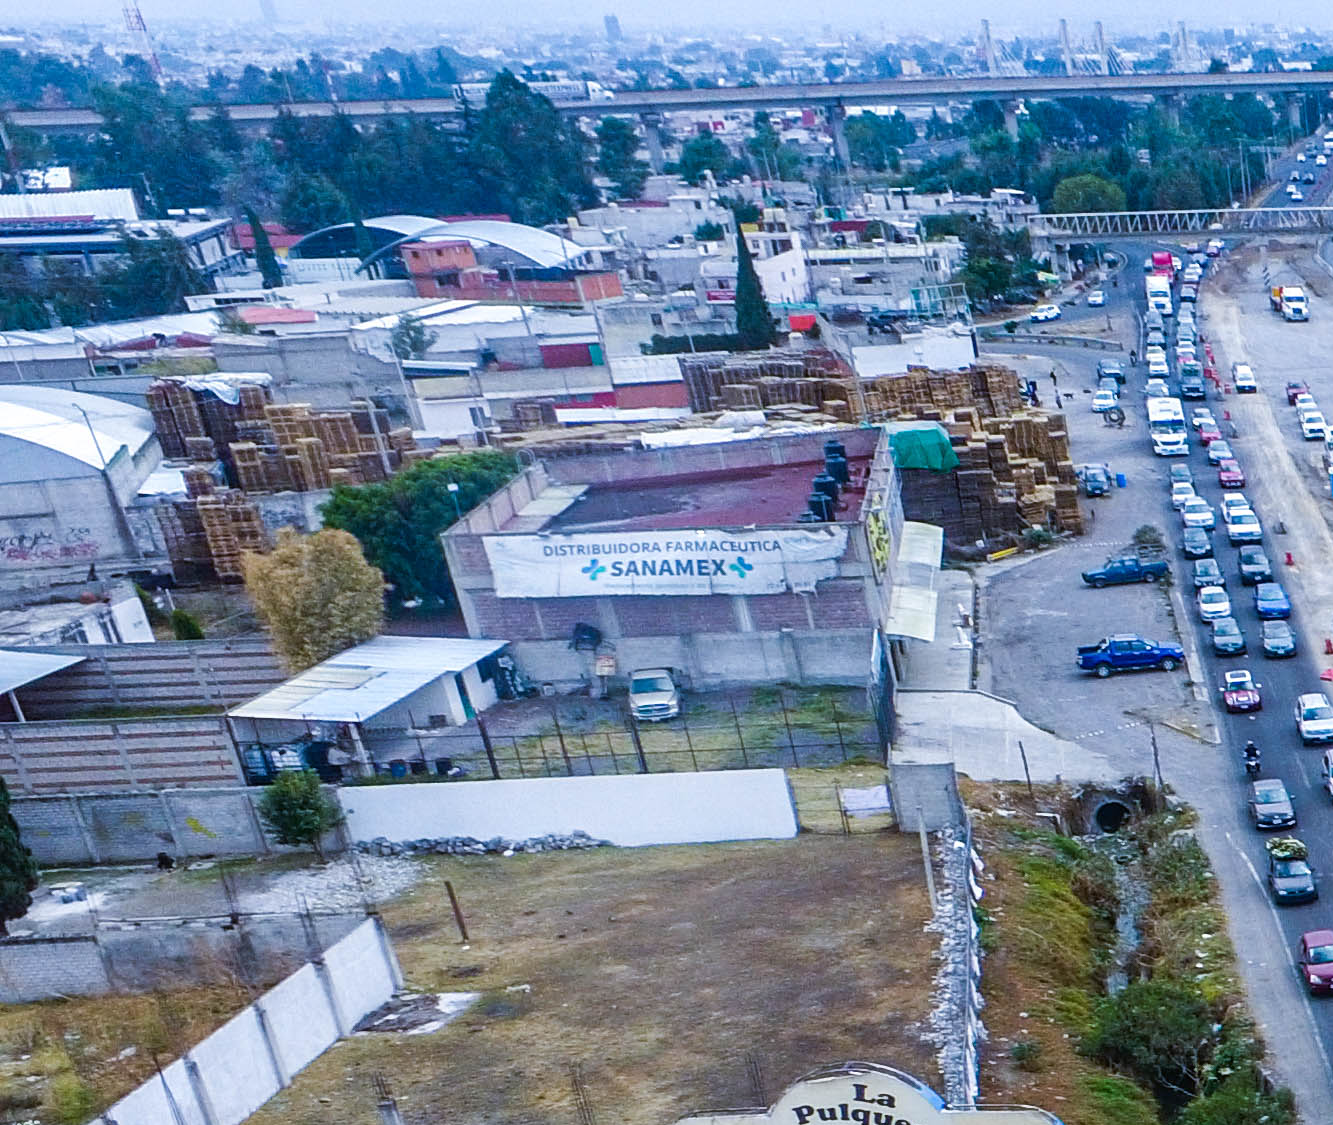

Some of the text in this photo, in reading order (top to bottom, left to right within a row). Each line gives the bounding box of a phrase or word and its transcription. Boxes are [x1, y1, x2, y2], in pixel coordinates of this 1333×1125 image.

[543, 540, 782, 557] DISTRIBUIDORA FARMACEUTICA
[610, 559, 727, 577] SANAMEX
[852, 1083, 896, 1108] La
